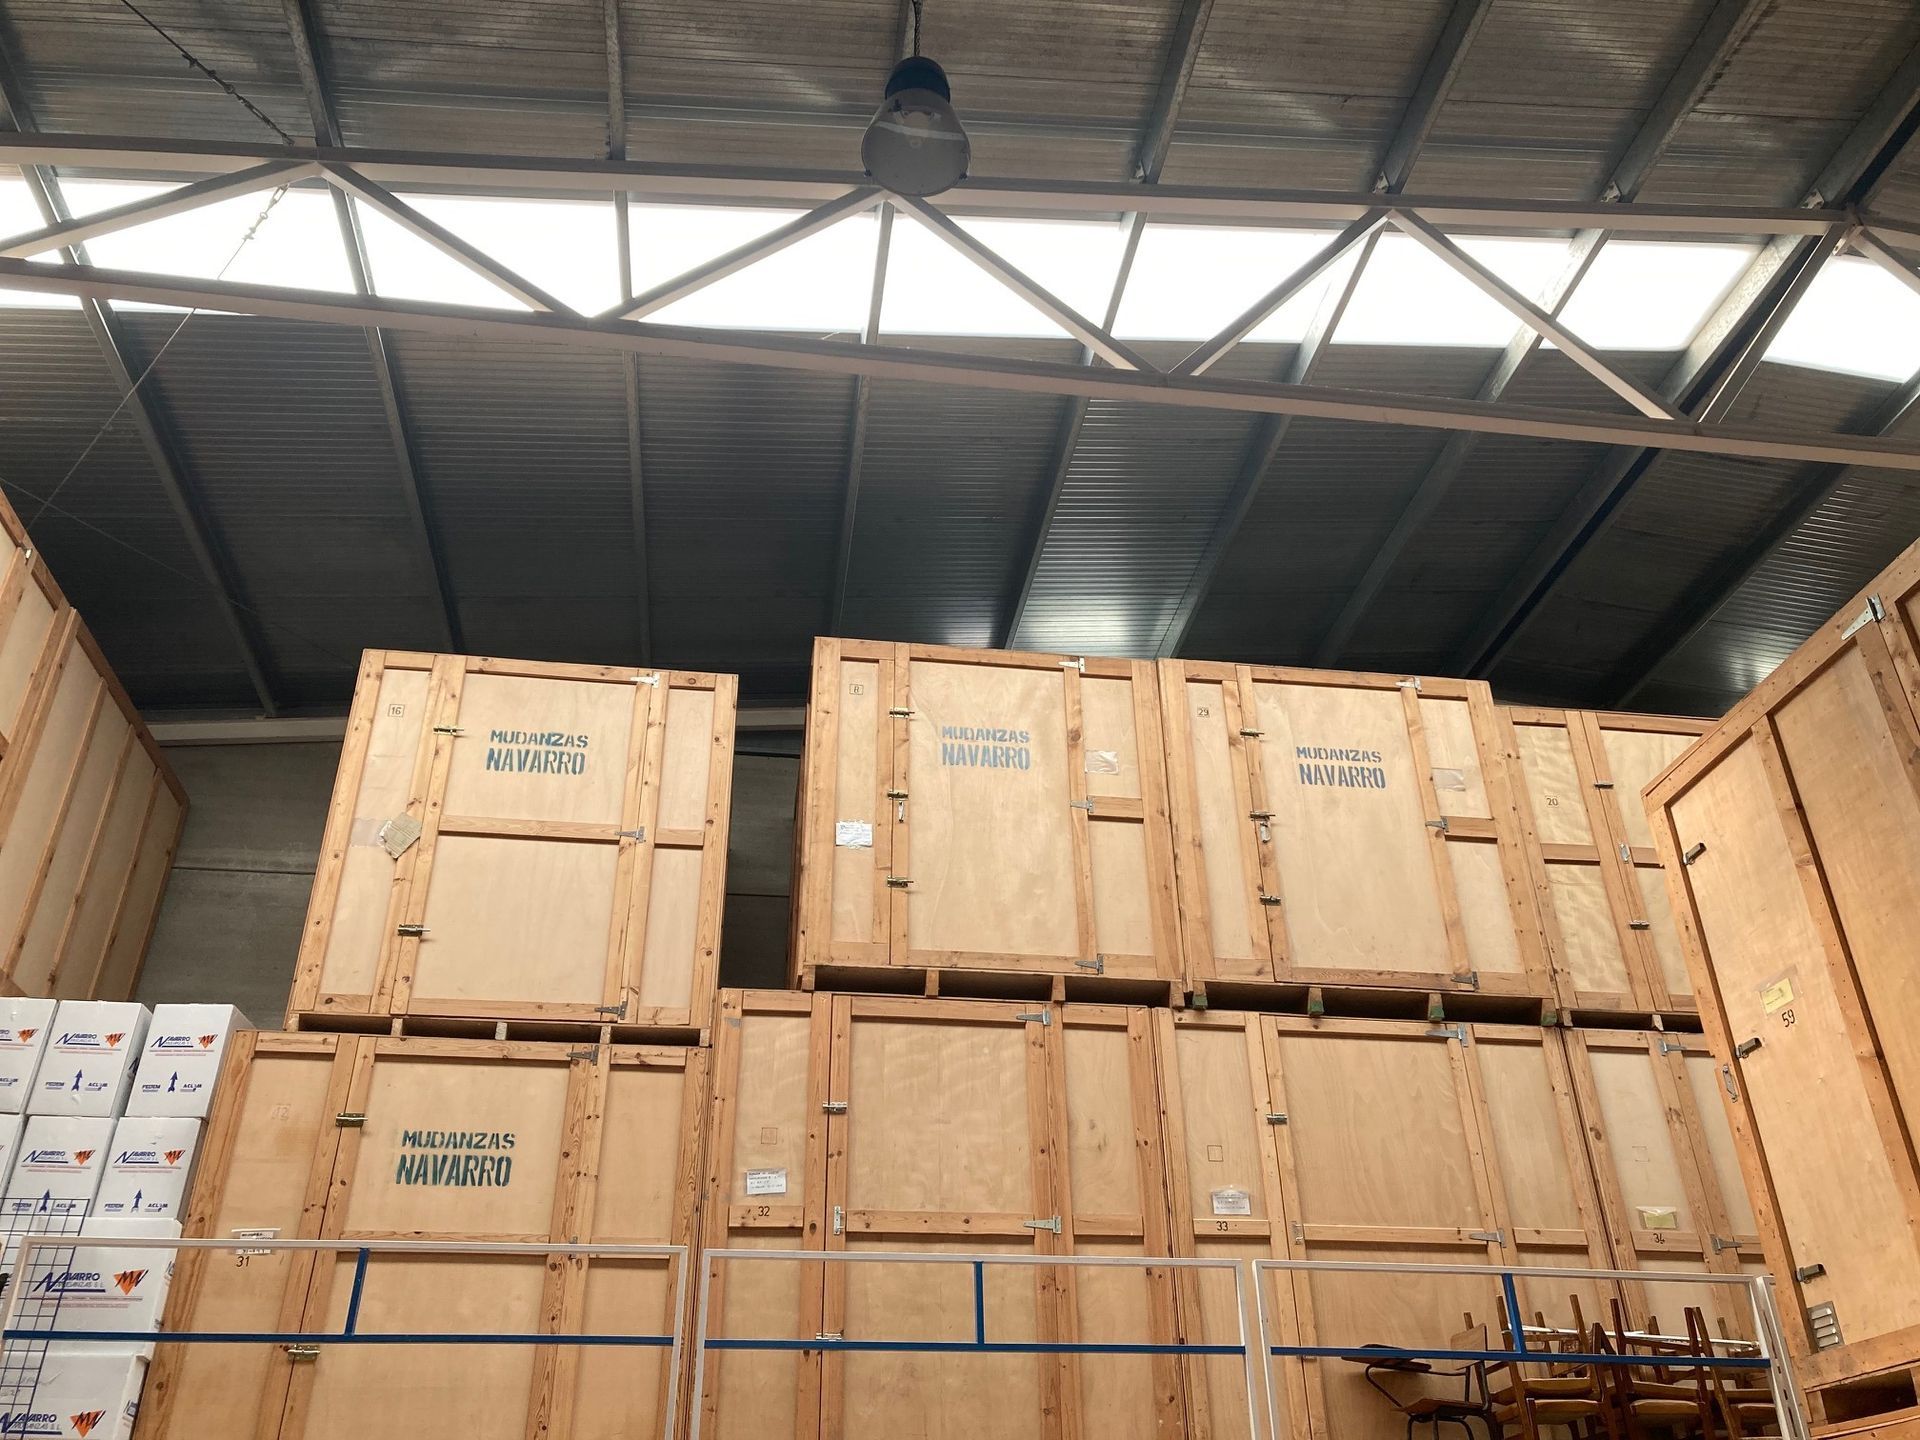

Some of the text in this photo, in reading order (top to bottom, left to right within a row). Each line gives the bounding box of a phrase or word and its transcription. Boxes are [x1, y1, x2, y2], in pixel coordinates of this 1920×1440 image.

[392, 706, 402, 715] 16
[1198, 707, 1209, 716] 29
[490, 730, 589, 748] MUDANZAS
[943, 726, 1030, 743] MUDANZAS
[486, 748, 586, 775] NAVARRO
[942, 743, 1031, 770] NAVARRO
[1296, 747, 1382, 763] MUDANZAS
[1299, 764, 1386, 789] NAVARRO
[1546, 797, 1559, 806] 20
[1781, 1009, 1796, 1028] 59
[401, 1130, 516, 1150] MUDANZAS
[396, 1154, 513, 1187] NAVARRO
[758, 1205, 770, 1217] 32
[1216, 1220, 1228, 1232] 33
[1653, 1233, 1665, 1244] 34
[236, 1255, 250, 1267] 31
[32, 1271, 101, 1292] NAVARRO
[0, 1412, 57, 1433] NAVARRO
